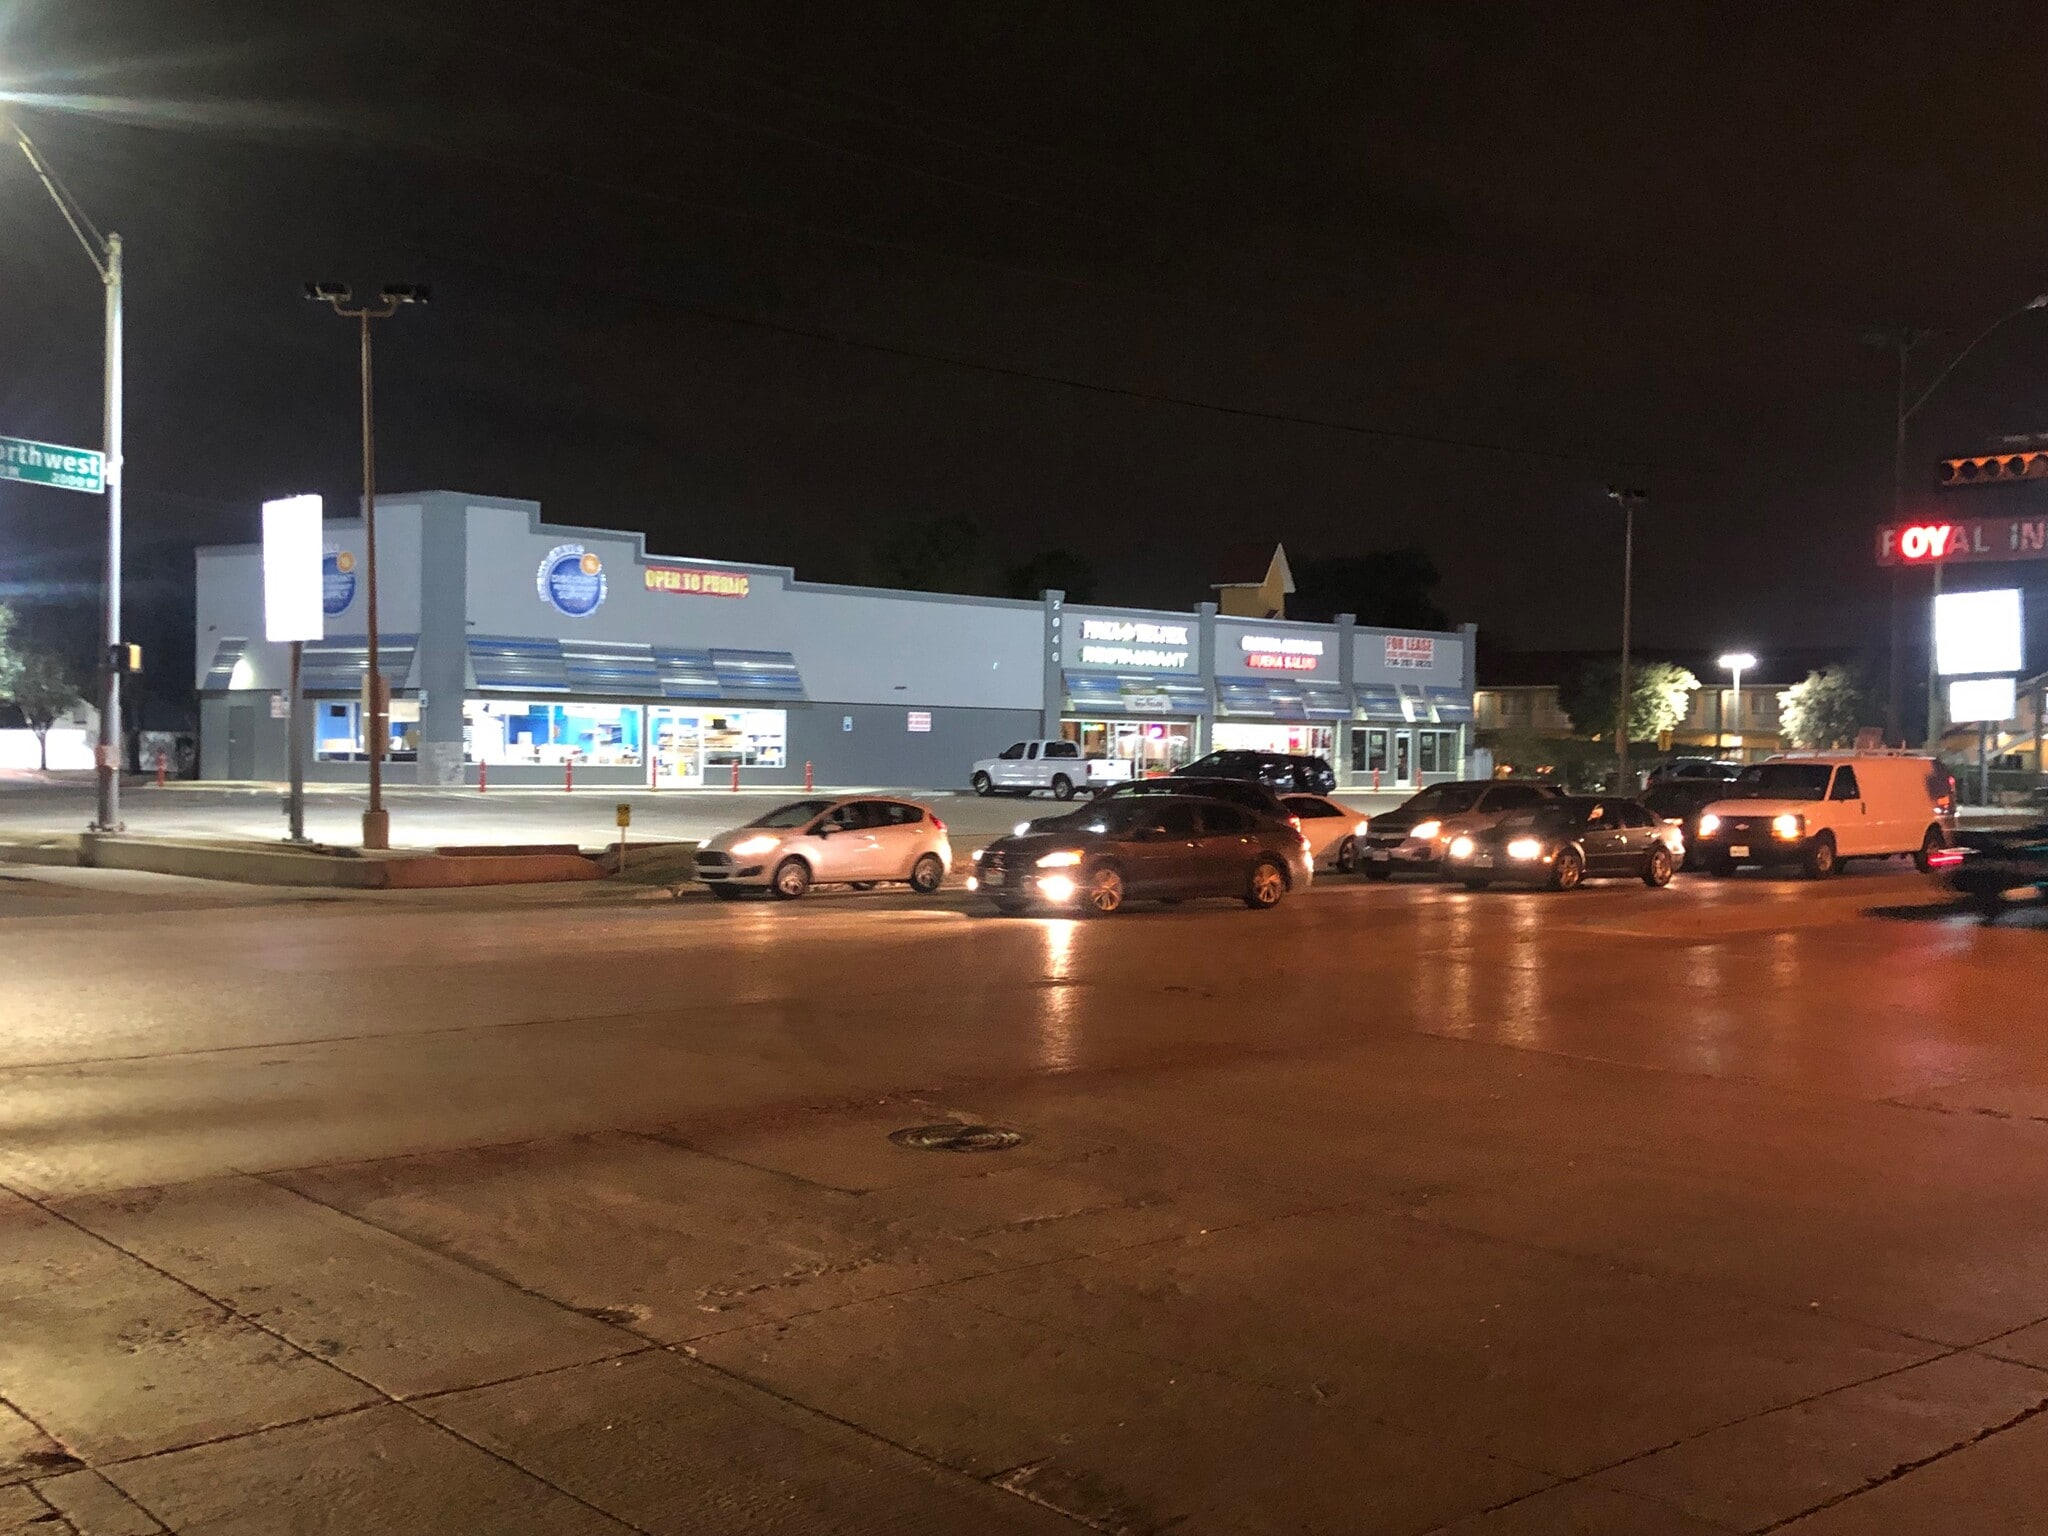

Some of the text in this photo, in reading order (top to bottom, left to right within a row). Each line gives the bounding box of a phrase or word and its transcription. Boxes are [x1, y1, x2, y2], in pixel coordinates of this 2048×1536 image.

[645, 570, 749, 595] OPEN TO PUBLIC
[1386, 636, 1433, 651] FOR LEASE
